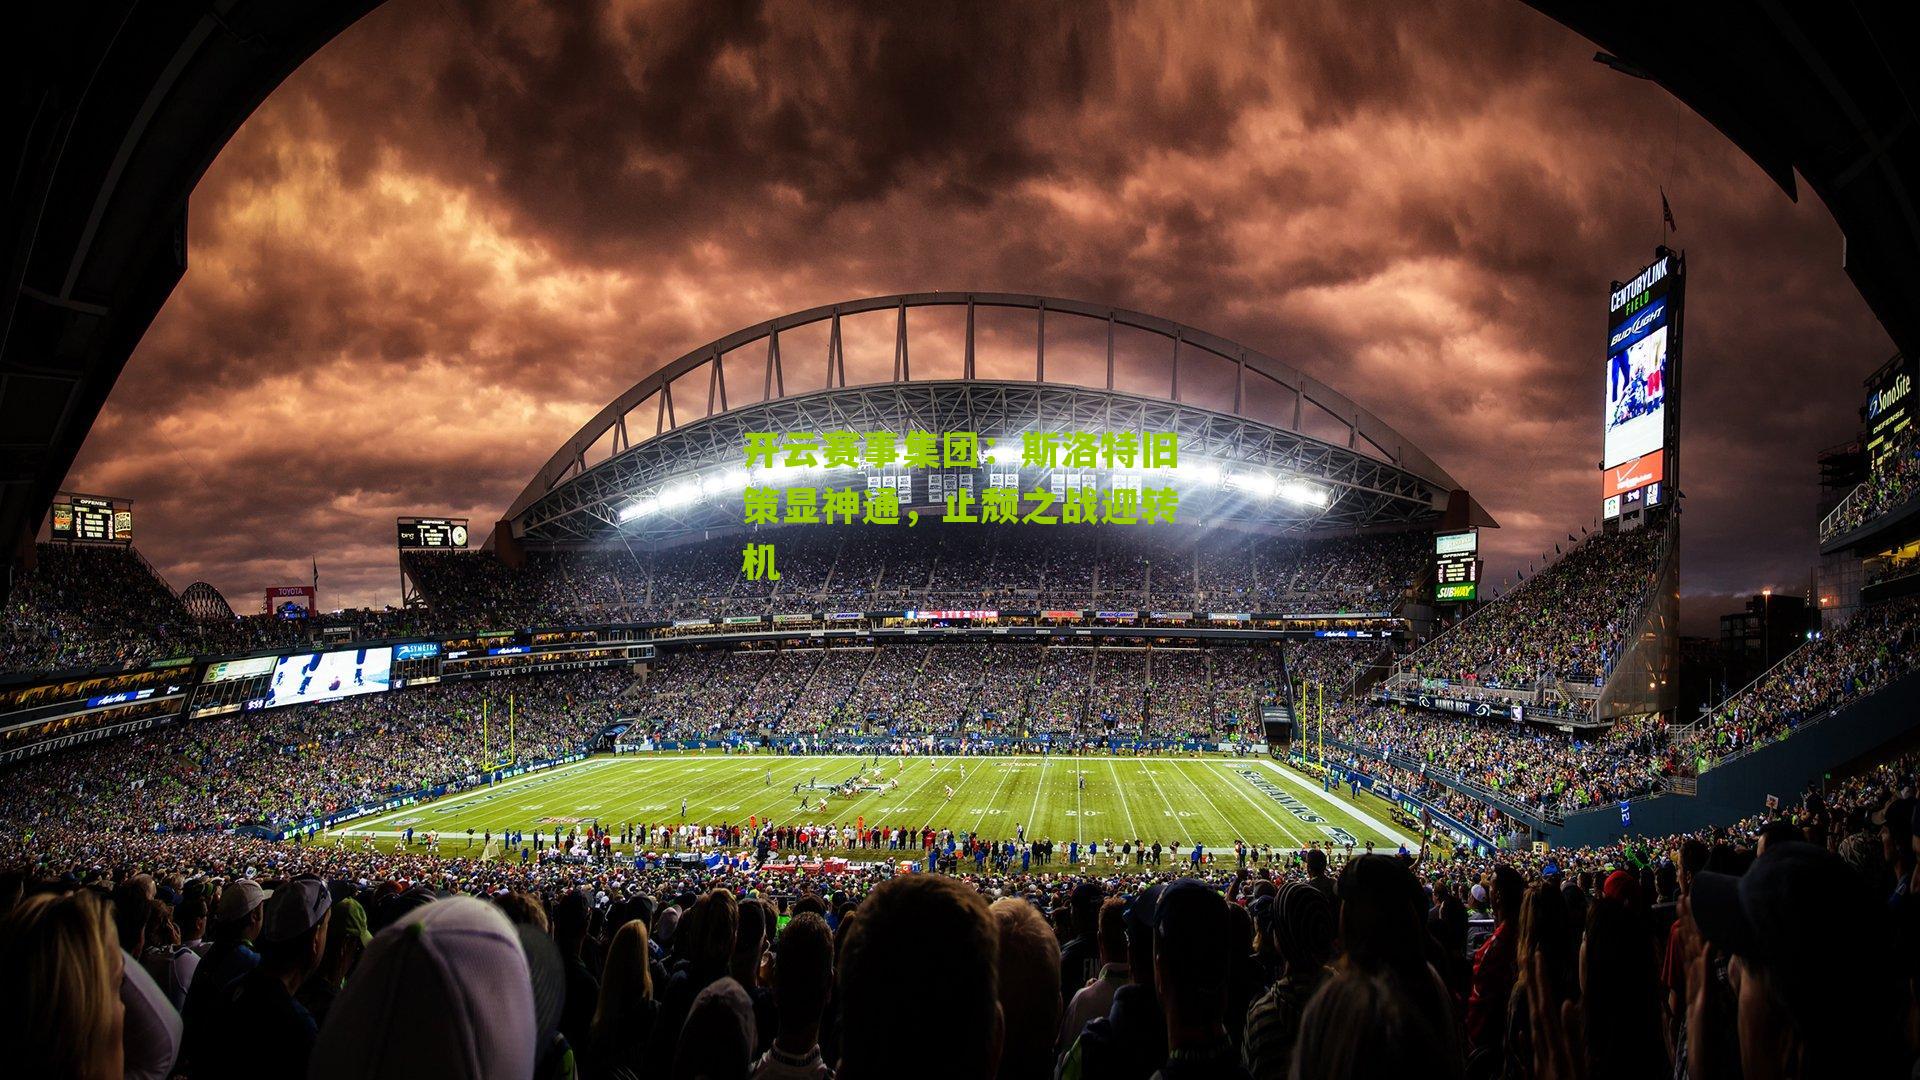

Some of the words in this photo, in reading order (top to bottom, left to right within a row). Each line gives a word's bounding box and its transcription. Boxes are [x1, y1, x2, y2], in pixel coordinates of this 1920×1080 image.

[1611, 256, 1668, 312] CENTURYLINK
[1625, 290, 1650, 316] FIELD
[1610, 327, 1632, 346] BUD
[1632, 305, 1664, 334] LIGHT
[1877, 373, 1911, 414] SonoSite
[1873, 407, 1905, 434] DEFENSE
[401, 532, 415, 540] bing
[278, 587, 303, 595] TOYOTA
[1437, 585, 1474, 598] SUBWAY
[410, 643, 438, 652] SYMETRA
[490, 669, 516, 677] HOME
[9, 751, 24, 762] TO
[29, 728, 112, 756] CENTURYLINK
[117, 720, 153, 735] FIELD
[1233, 769, 1328, 823] SEAHAWKS
[1620, 806, 1630, 822] 12
